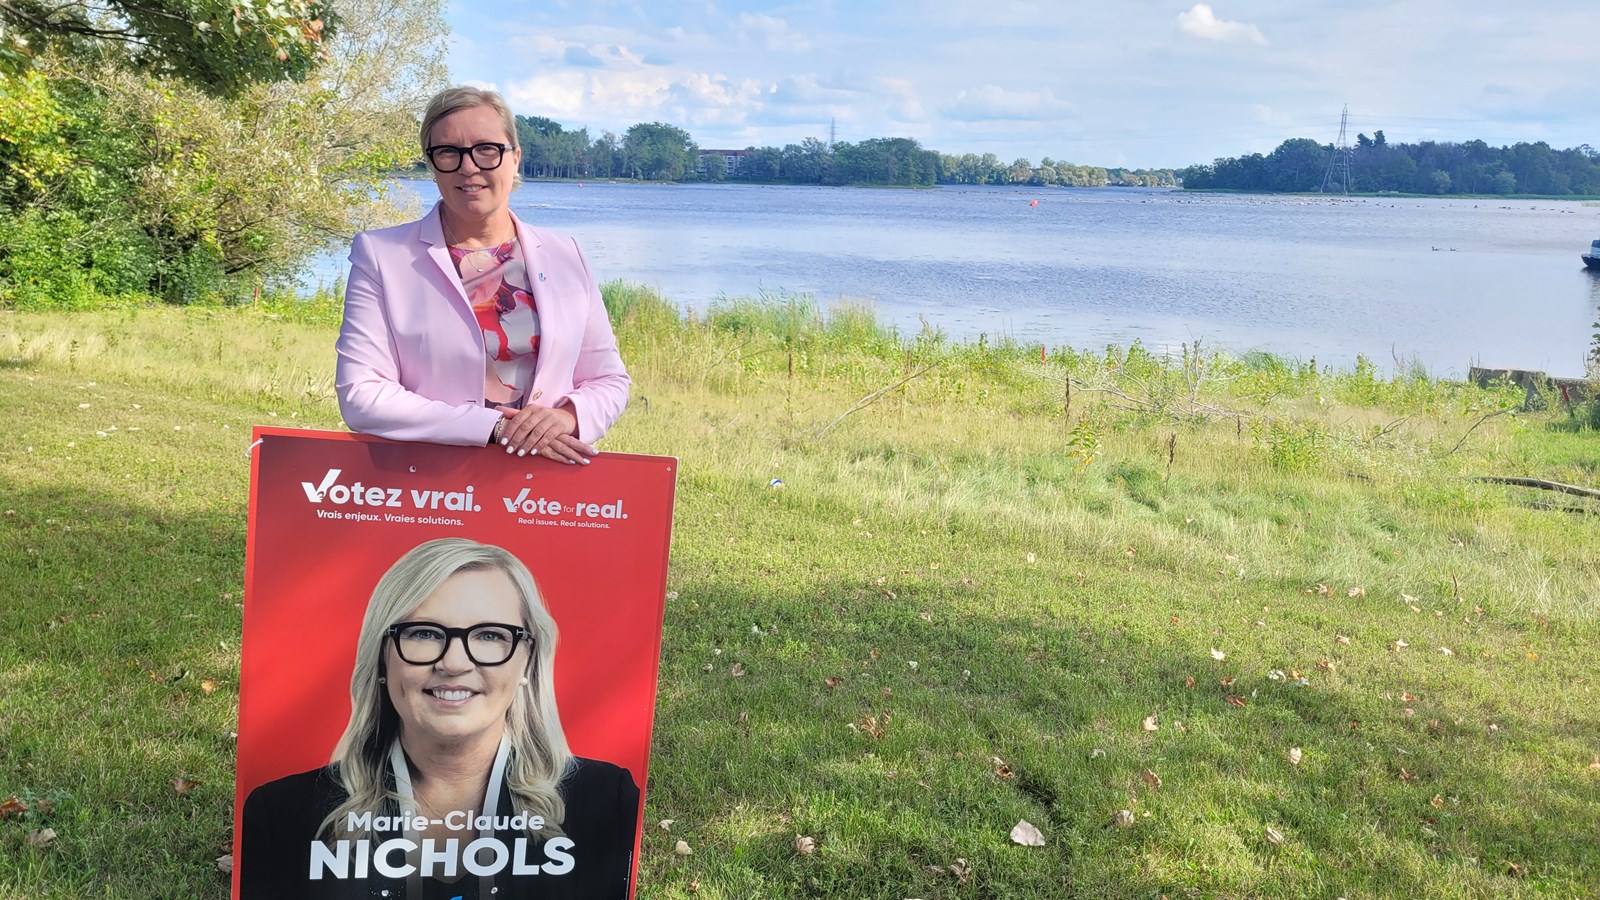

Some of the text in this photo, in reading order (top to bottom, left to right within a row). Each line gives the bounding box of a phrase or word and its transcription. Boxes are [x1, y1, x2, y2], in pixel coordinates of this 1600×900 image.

[301, 469, 482, 512] Votez vrai.
[503, 488, 628, 519] Vote for real.
[317, 509, 464, 526] Vrais enjeux. Vraies solutions.
[518, 517, 611, 529] Real issues. Real solutions.
[347, 810, 545, 832] Marie-Claude
[309, 836, 576, 880] NICHOLS
